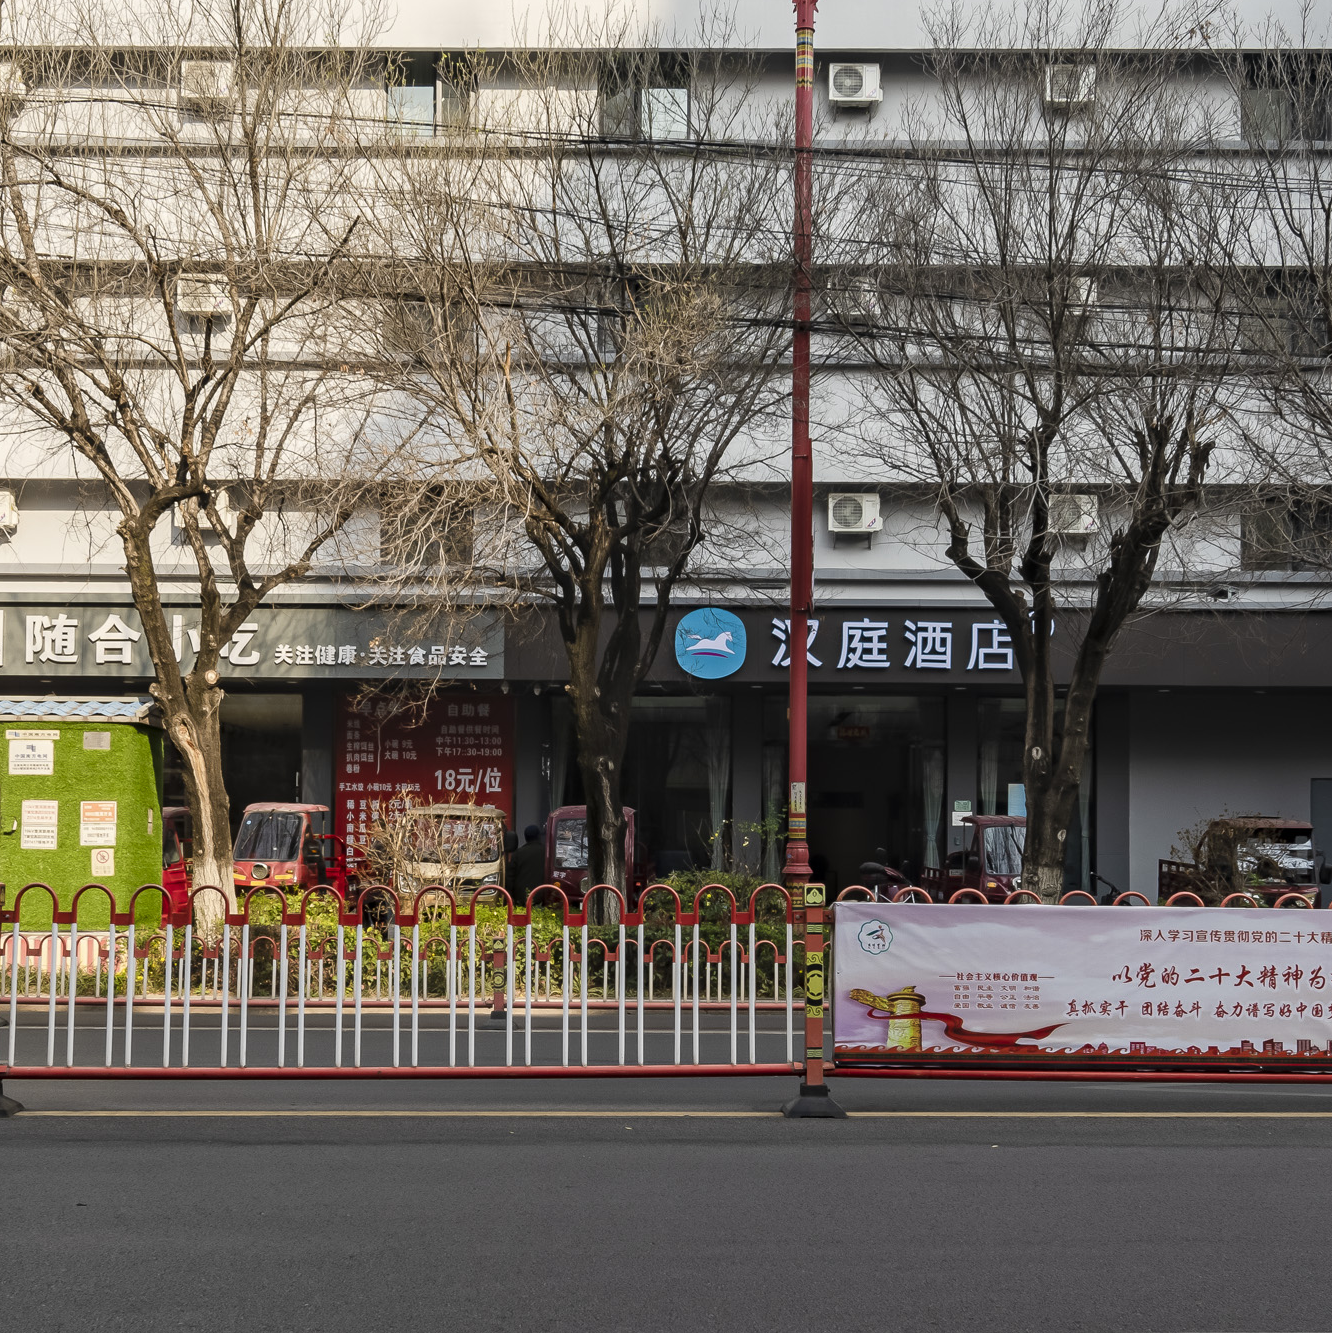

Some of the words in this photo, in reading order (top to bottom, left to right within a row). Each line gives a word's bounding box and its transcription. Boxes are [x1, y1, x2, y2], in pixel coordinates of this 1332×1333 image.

[771, 618, 1013, 670] 汉庭酒店
[447, 704, 490, 717] 自助餐
[384, 751, 399, 760] 大碗
[402, 751, 417, 760] 10元
[434, 767, 502, 793] 18元/位
[956, 972, 1038, 982] 社会主义核心价值观
[1066, 1000, 1130, 1018] 真抓实干
[1141, 1000, 1203, 1019] 团结奋斗
